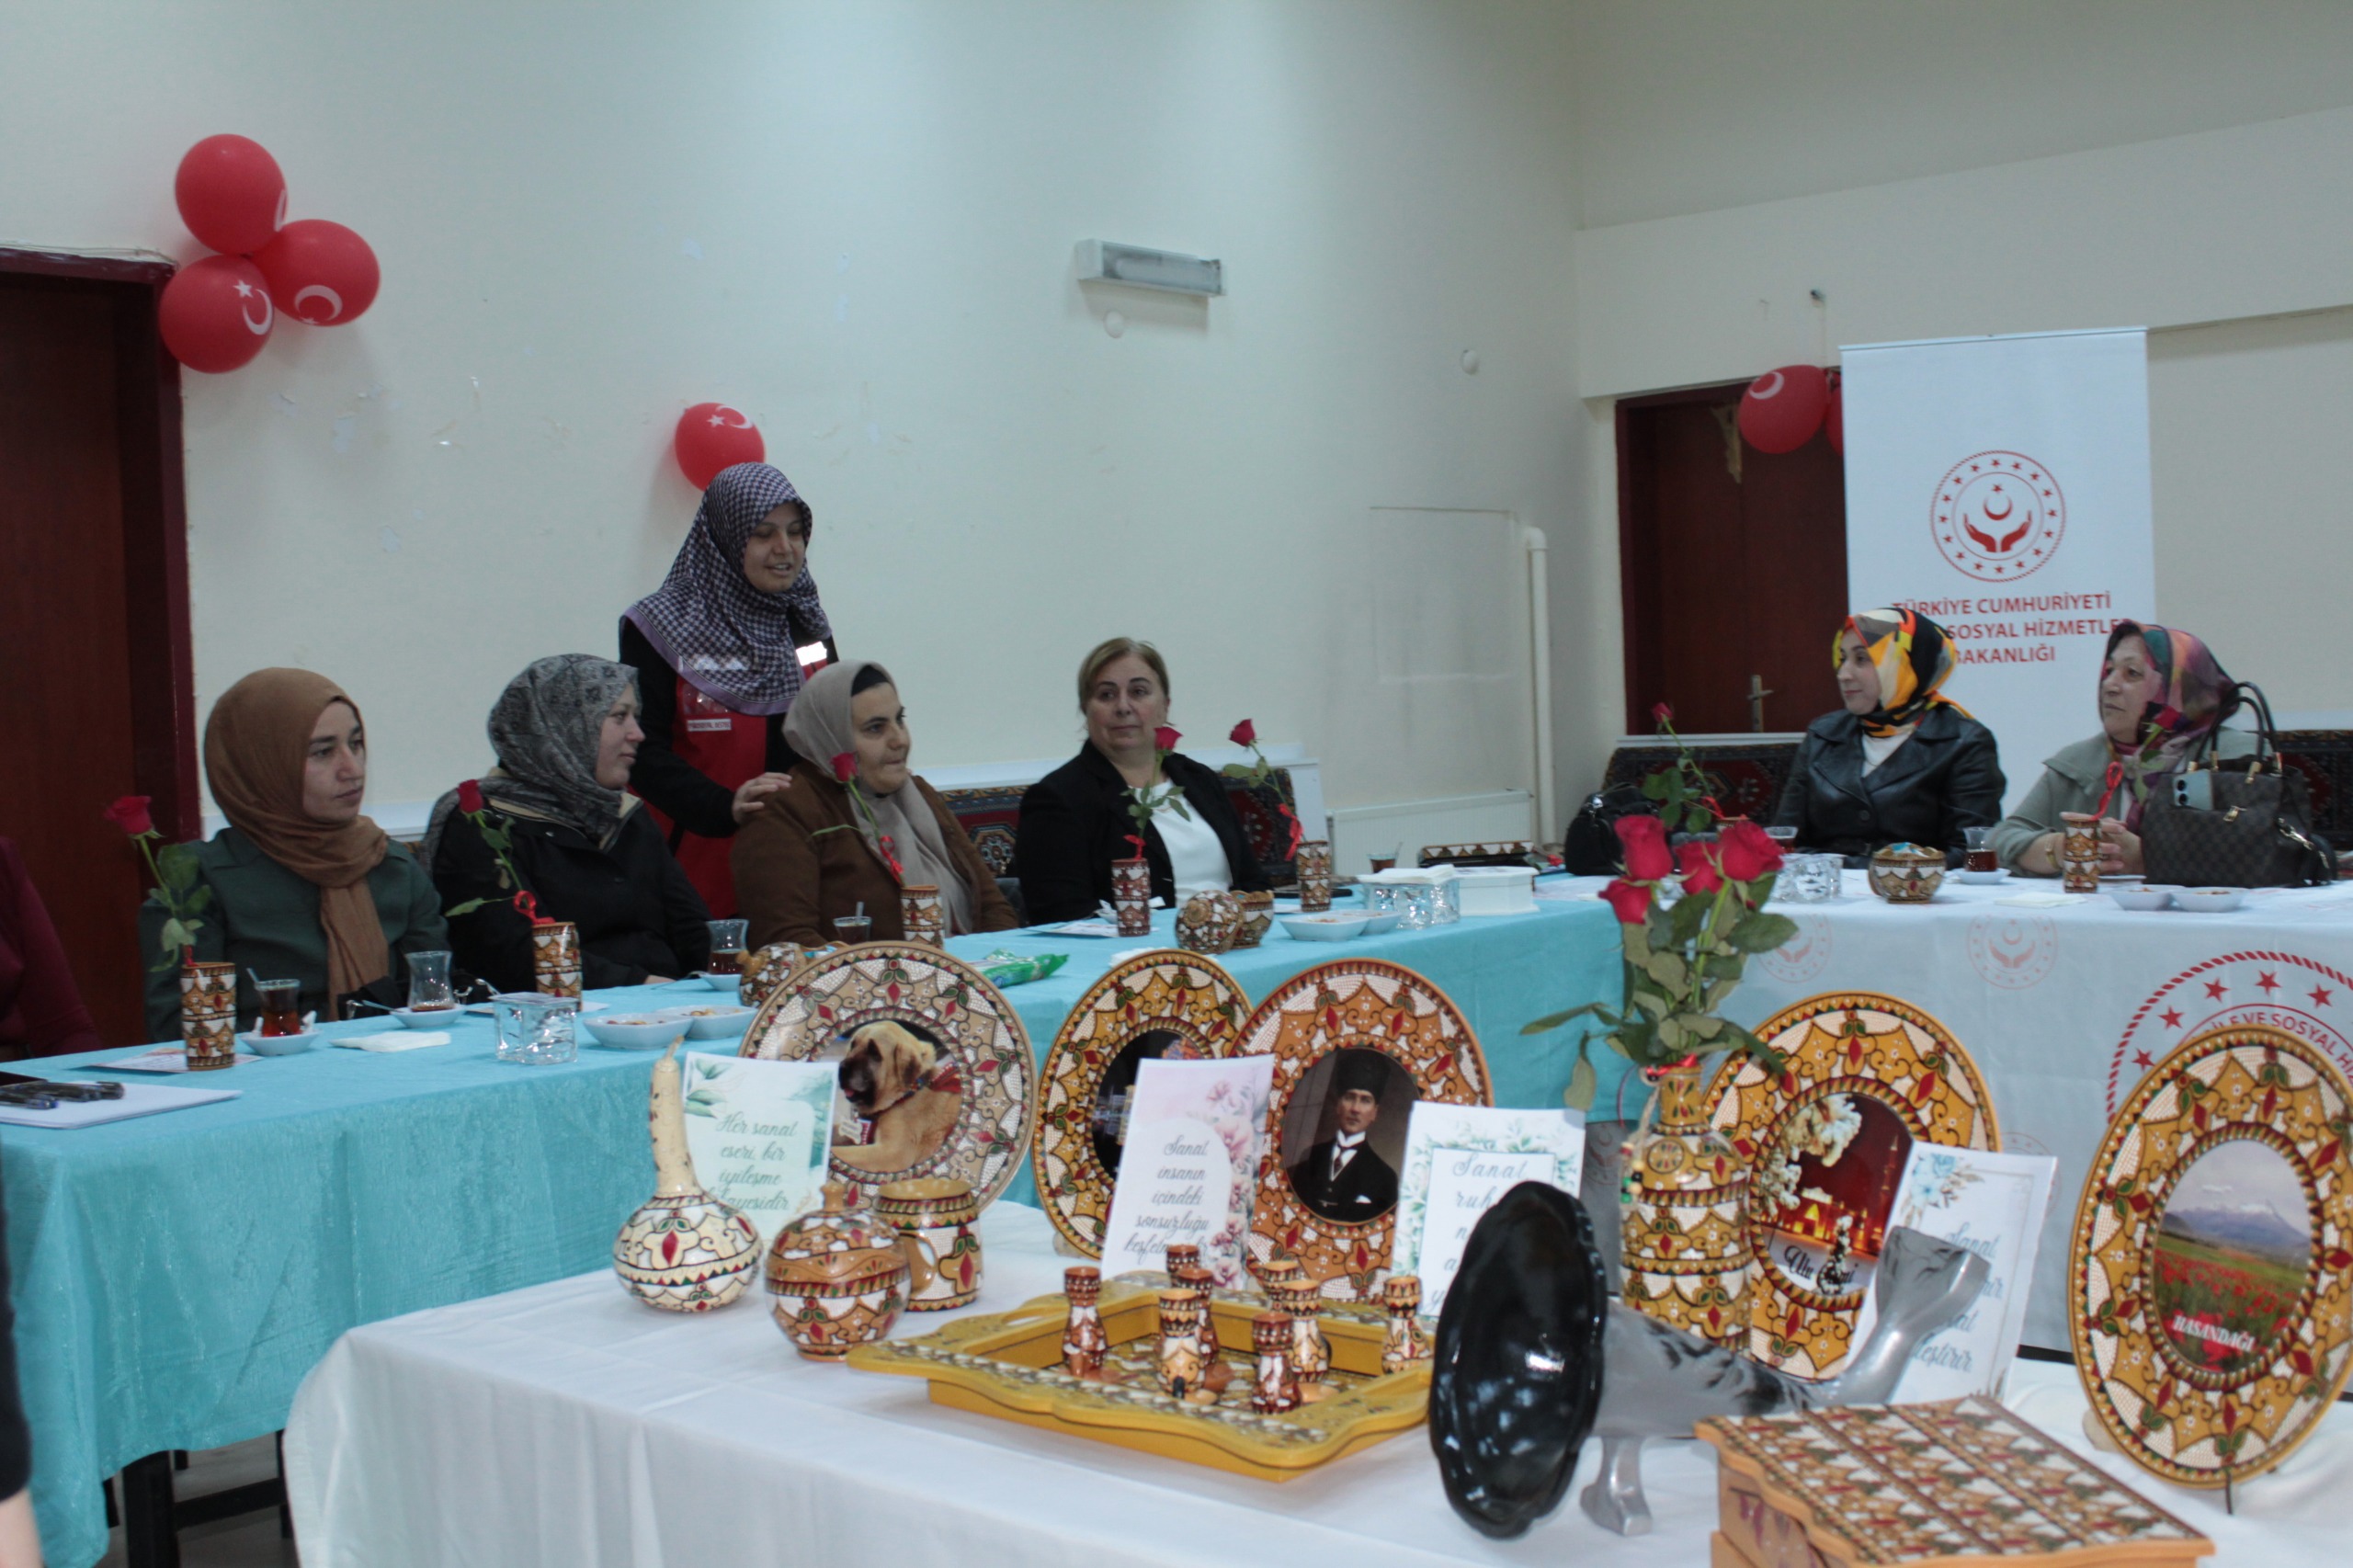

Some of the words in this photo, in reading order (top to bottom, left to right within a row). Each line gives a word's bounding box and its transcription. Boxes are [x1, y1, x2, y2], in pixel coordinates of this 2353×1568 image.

[1891, 597, 1972, 616] TÜRKİYE
[1975, 590, 2112, 614] CUMHURİYETİ
[1949, 622, 2019, 640] SOSYAL
[2024, 619, 2120, 637] HİZMETLE
[2271, 1013, 2336, 1056] SOSYAL
[715, 1111, 749, 1135] Her
[752, 1121, 798, 1137] sanat
[762, 1141, 787, 1162] bir
[1164, 1133, 1208, 1156] Sanat
[1452, 1152, 1529, 1179] Sanat
[1152, 1186, 1204, 1207] içindeki
[1134, 1209, 1210, 1239] sonsuzluğu
[1784, 1245, 1813, 1281] Ulu
[2171, 1314, 2256, 1352] HASANDAĞI
